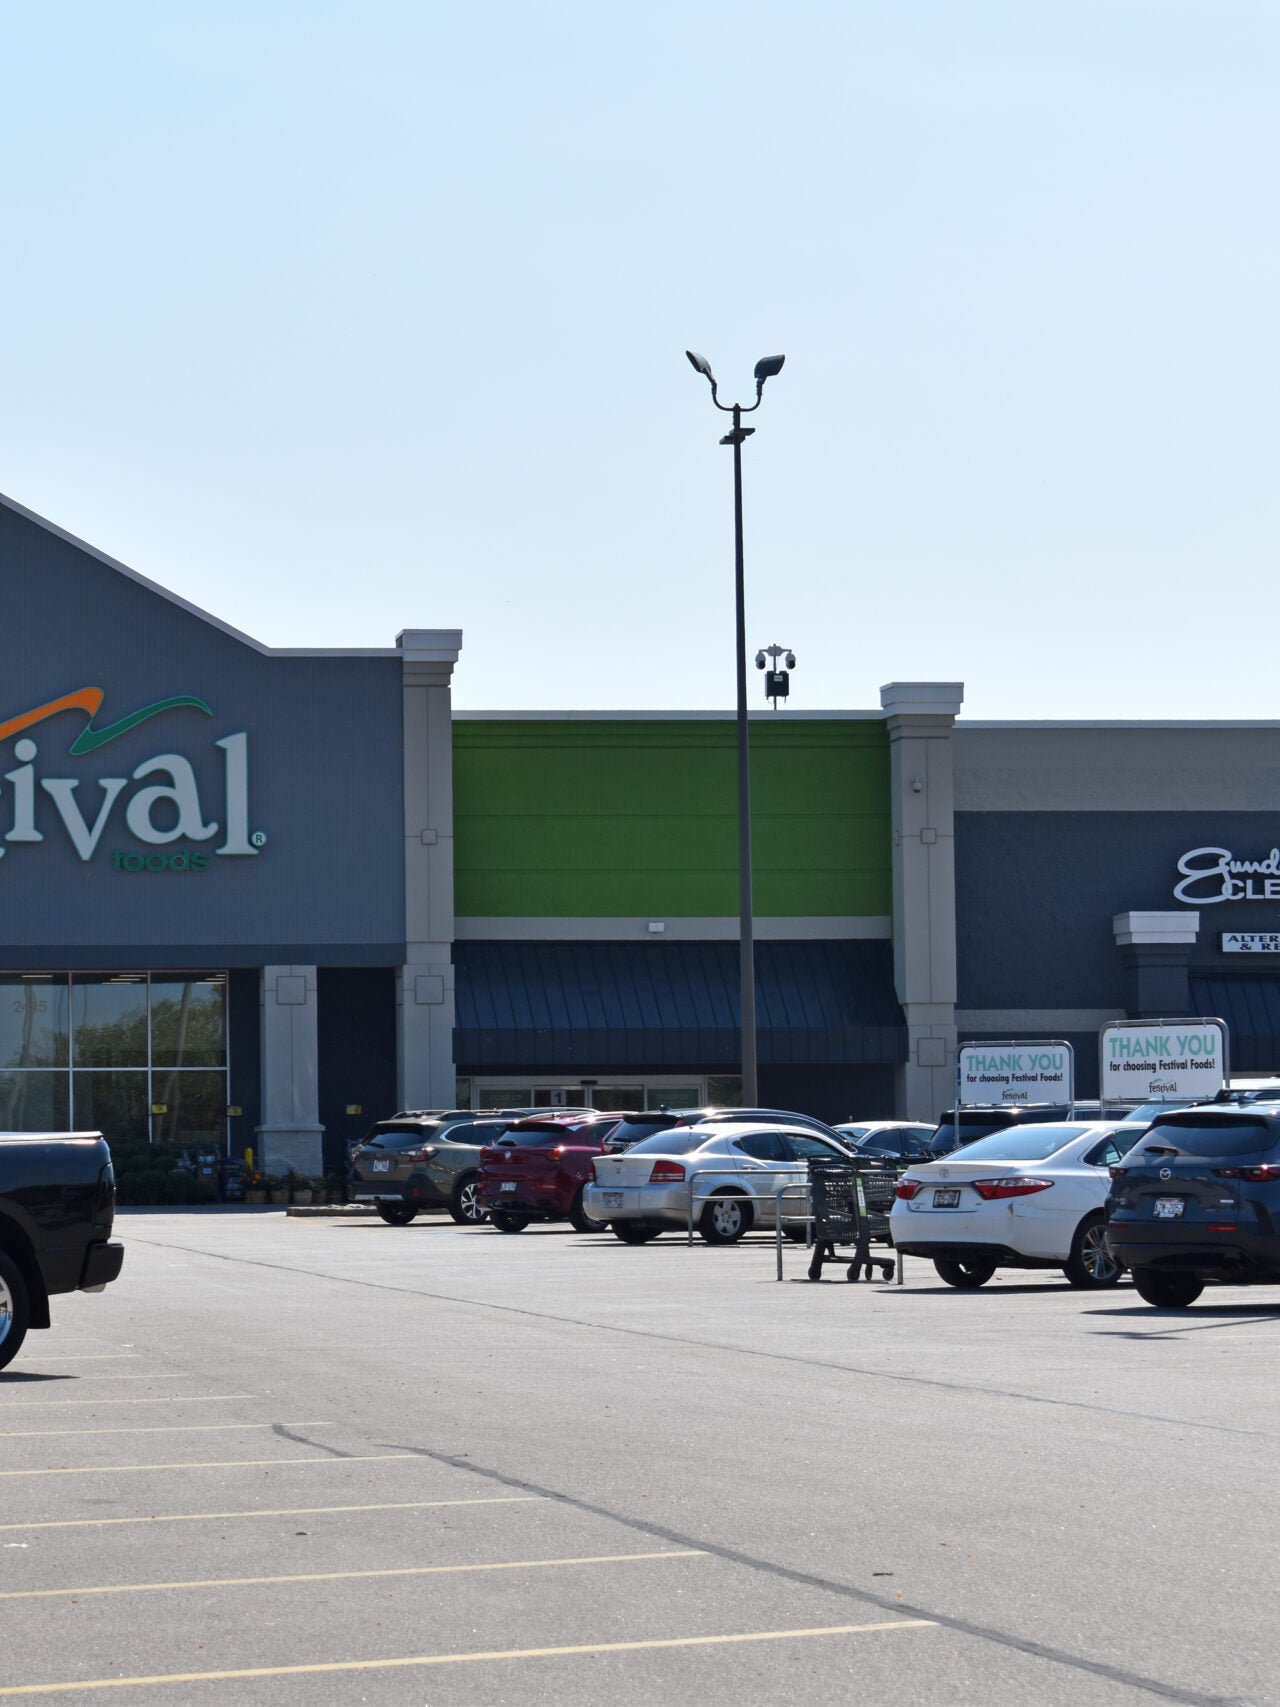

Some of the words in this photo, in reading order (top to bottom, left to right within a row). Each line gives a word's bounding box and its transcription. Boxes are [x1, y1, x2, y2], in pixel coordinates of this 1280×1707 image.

[112, 848, 211, 872] foods
[1109, 1035, 1171, 1057] THANK
[1176, 1034, 1215, 1056] YOU
[966, 1054, 1023, 1071] THANK
[1028, 1053, 1063, 1070] YOU
[1110, 1061, 1120, 1071] for
[1123, 1061, 1156, 1073] choosing
[1159, 1060, 1187, 1070] Festival
[1190, 1058, 1215, 1069] Foods!
[967, 1074, 976, 1083] for
[980, 1073, 1009, 1084] choosing
[1011, 1073, 1038, 1082] Festival
[1040, 1073, 1063, 1081] Foods!
[1149, 1081, 1177, 1093] festival
[1002, 1090, 1028, 1100] festival
